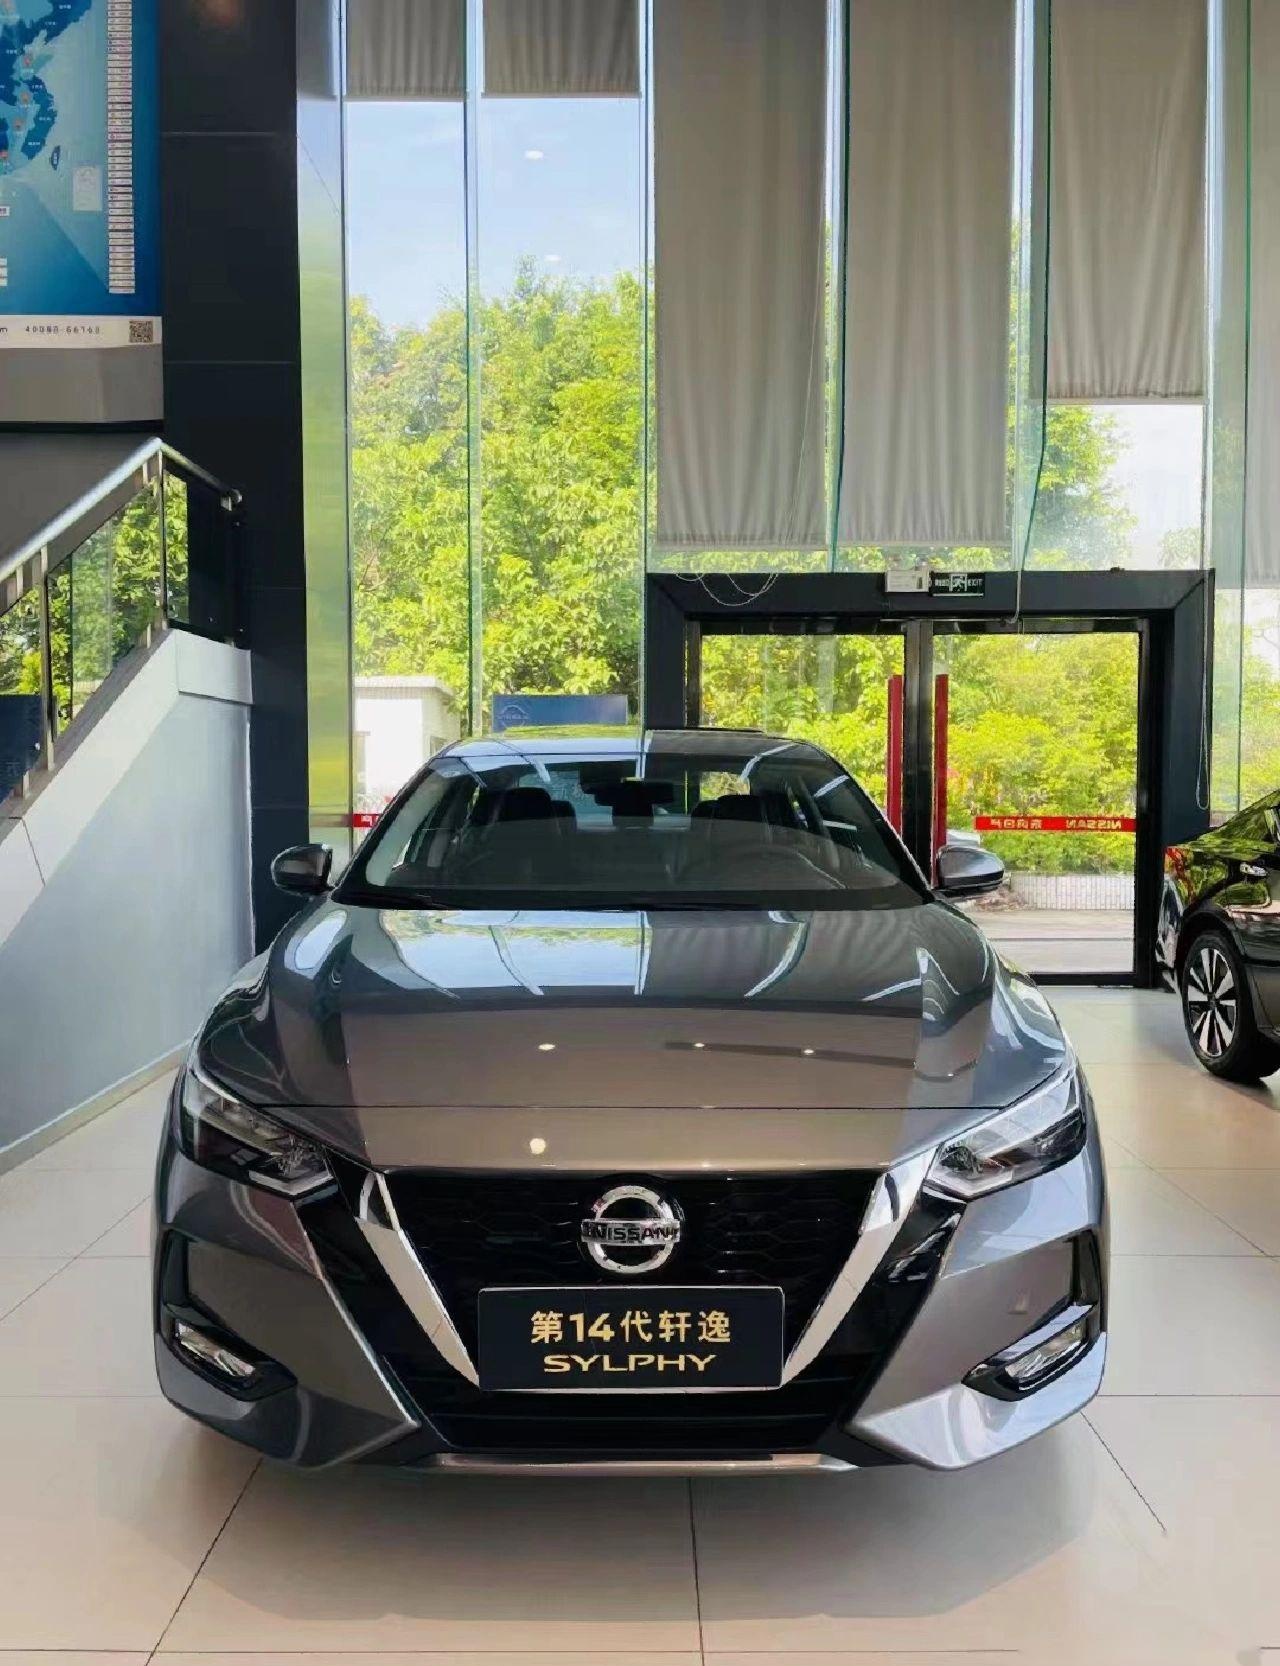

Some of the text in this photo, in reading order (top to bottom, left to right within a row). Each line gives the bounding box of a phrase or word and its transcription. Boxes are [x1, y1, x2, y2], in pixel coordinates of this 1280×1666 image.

[591, 1225, 671, 1241] NISSAN
[530, 1310, 731, 1344] 第14代轩逸
[543, 1354, 717, 1373] SYLPHY
